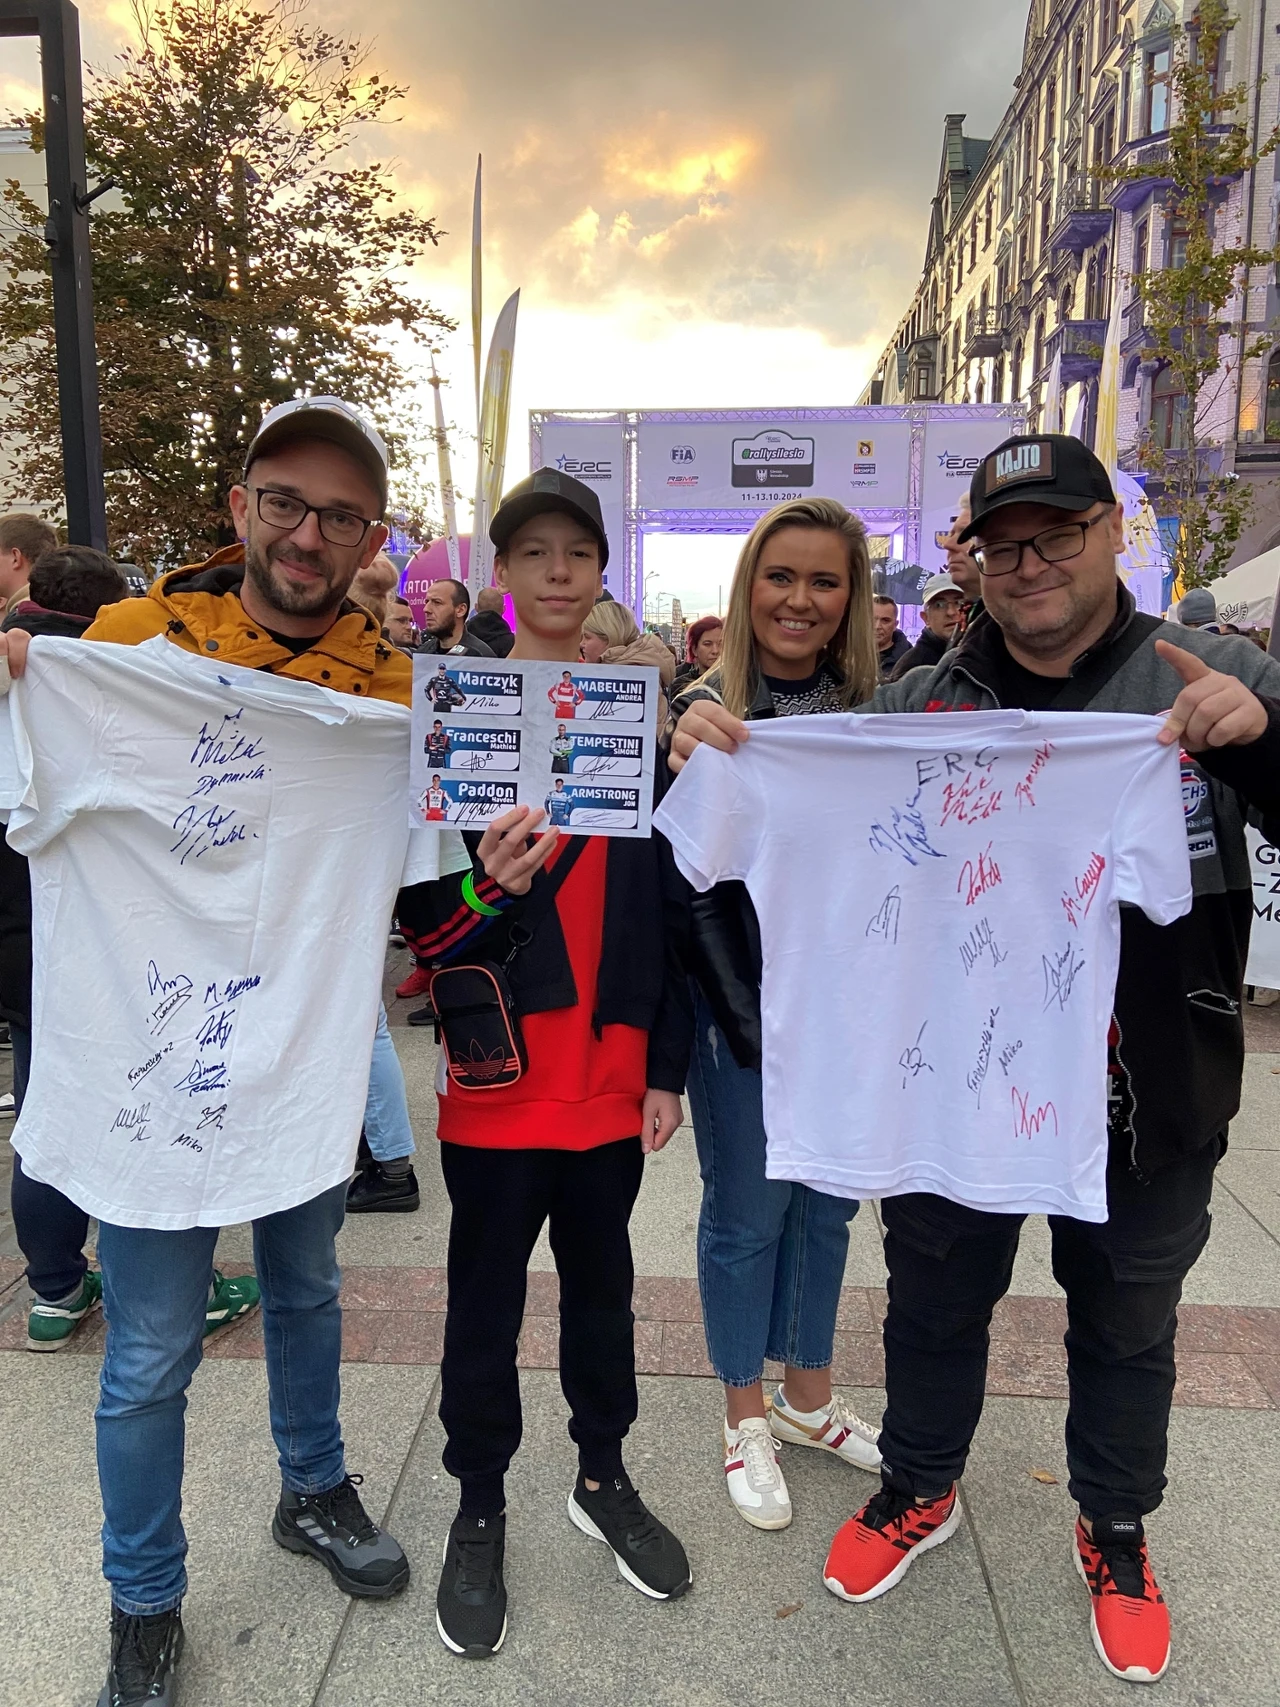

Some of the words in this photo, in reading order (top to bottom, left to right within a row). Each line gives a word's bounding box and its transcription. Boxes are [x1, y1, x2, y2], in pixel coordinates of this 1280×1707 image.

[742, 448, 804, 461] #rallysilesia
[996, 445, 1040, 477] KAJTO
[564, 462, 611, 472] ERC
[946, 458, 985, 468] ER
[741, 493, 802, 501] 11-13.10.2024
[458, 672, 518, 689] Marczyk
[578, 681, 642, 694] MABELLINI
[616, 694, 642, 702] ANDREA
[446, 729, 517, 744] Franceschi
[570, 736, 639, 749] TEMPESTINI
[613, 748, 639, 756] SIMONE
[916, 746, 999, 786] ERC
[458, 783, 514, 798] Paddon
[571, 788, 636, 801] ARMSTRONG
[171, 1133, 203, 1153] Miko
